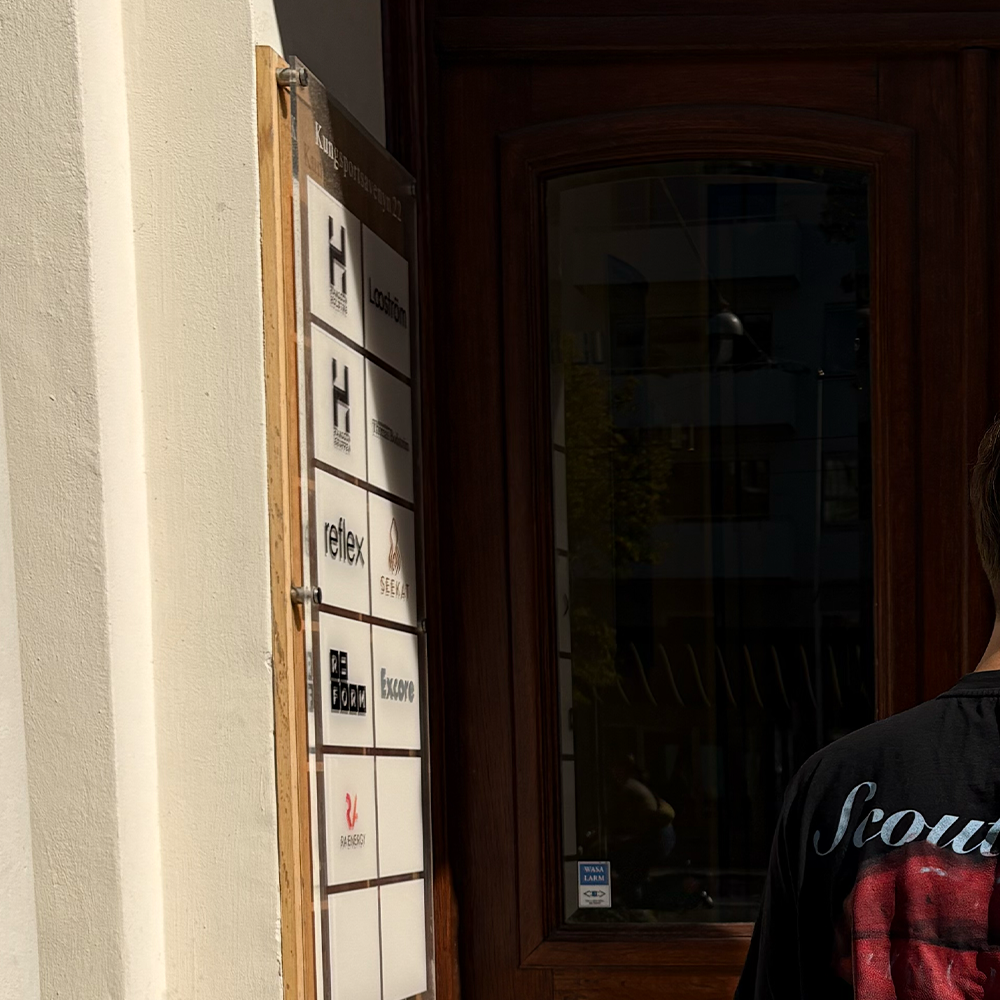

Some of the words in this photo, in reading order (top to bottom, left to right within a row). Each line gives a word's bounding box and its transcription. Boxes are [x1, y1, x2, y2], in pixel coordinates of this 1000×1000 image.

[368, 276, 408, 329] Looström
[324, 517, 365, 567] reflex
[331, 684, 366, 711] FORM
[380, 667, 415, 703] Excore
[583, 865, 605, 873] WASA
[583, 874, 606, 882] LARM
